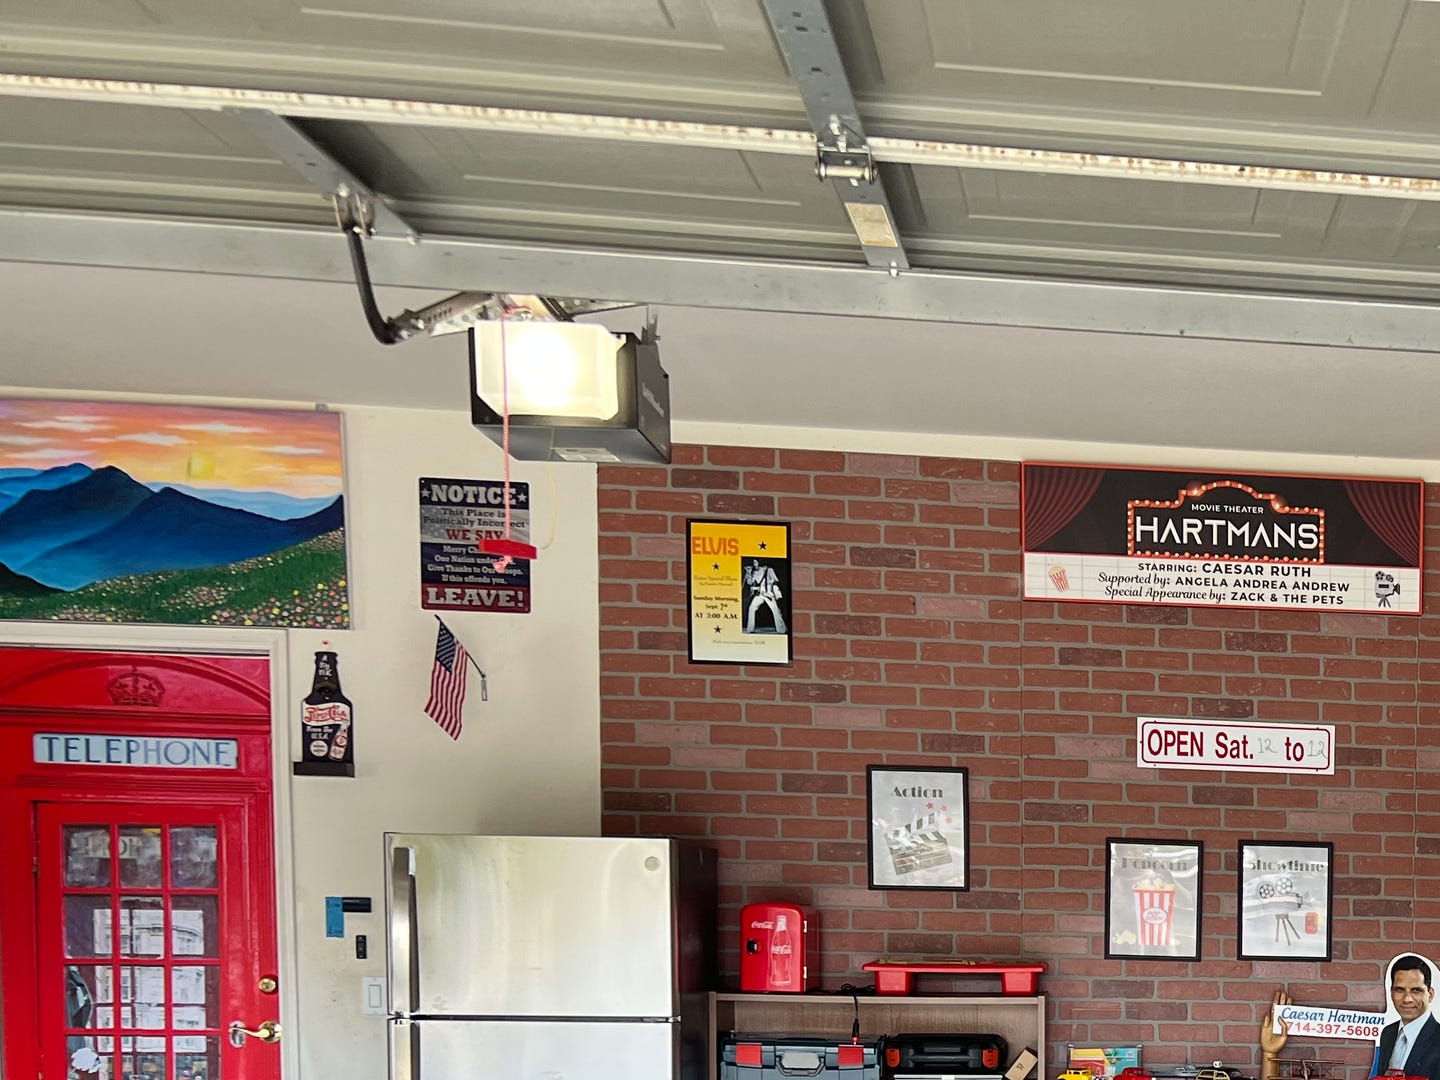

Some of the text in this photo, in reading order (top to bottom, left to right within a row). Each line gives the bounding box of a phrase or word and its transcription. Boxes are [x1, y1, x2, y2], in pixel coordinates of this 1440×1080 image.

[431, 484, 517, 505] NOTICE
[441, 508, 465, 516] This
[467, 509, 495, 518] Place
[1191, 504, 1264, 514] MOVIE THEATER
[423, 516, 476, 528] Politically
[445, 528, 504, 541] WE SAY
[1135, 516, 1319, 550] HARTMANS
[443, 545, 467, 554] Merry
[691, 536, 739, 556] ELVIS
[451, 555, 475, 563] Nation
[427, 564, 444, 572] Give
[445, 565, 472, 573] Thanks
[1138, 563, 1311, 577] STARRING: CAESAR RUTH
[464, 575, 491, 584] offends
[1098, 571, 1350, 592] Supported by: ANGELA ANDREA ANDREW
[427, 587, 524, 607] LEAVE!
[1105, 585, 1344, 605] Special Appearance by: ZACK & THE PETS
[41, 737, 232, 766] TELEPHONE
[1147, 729, 1329, 762] OPEN Sat. 12 to 12
[890, 786, 943, 798] Action
[1281, 1007, 1385, 1026] Caesar Hartman
[1287, 1021, 1379, 1037] 714-397-5608
